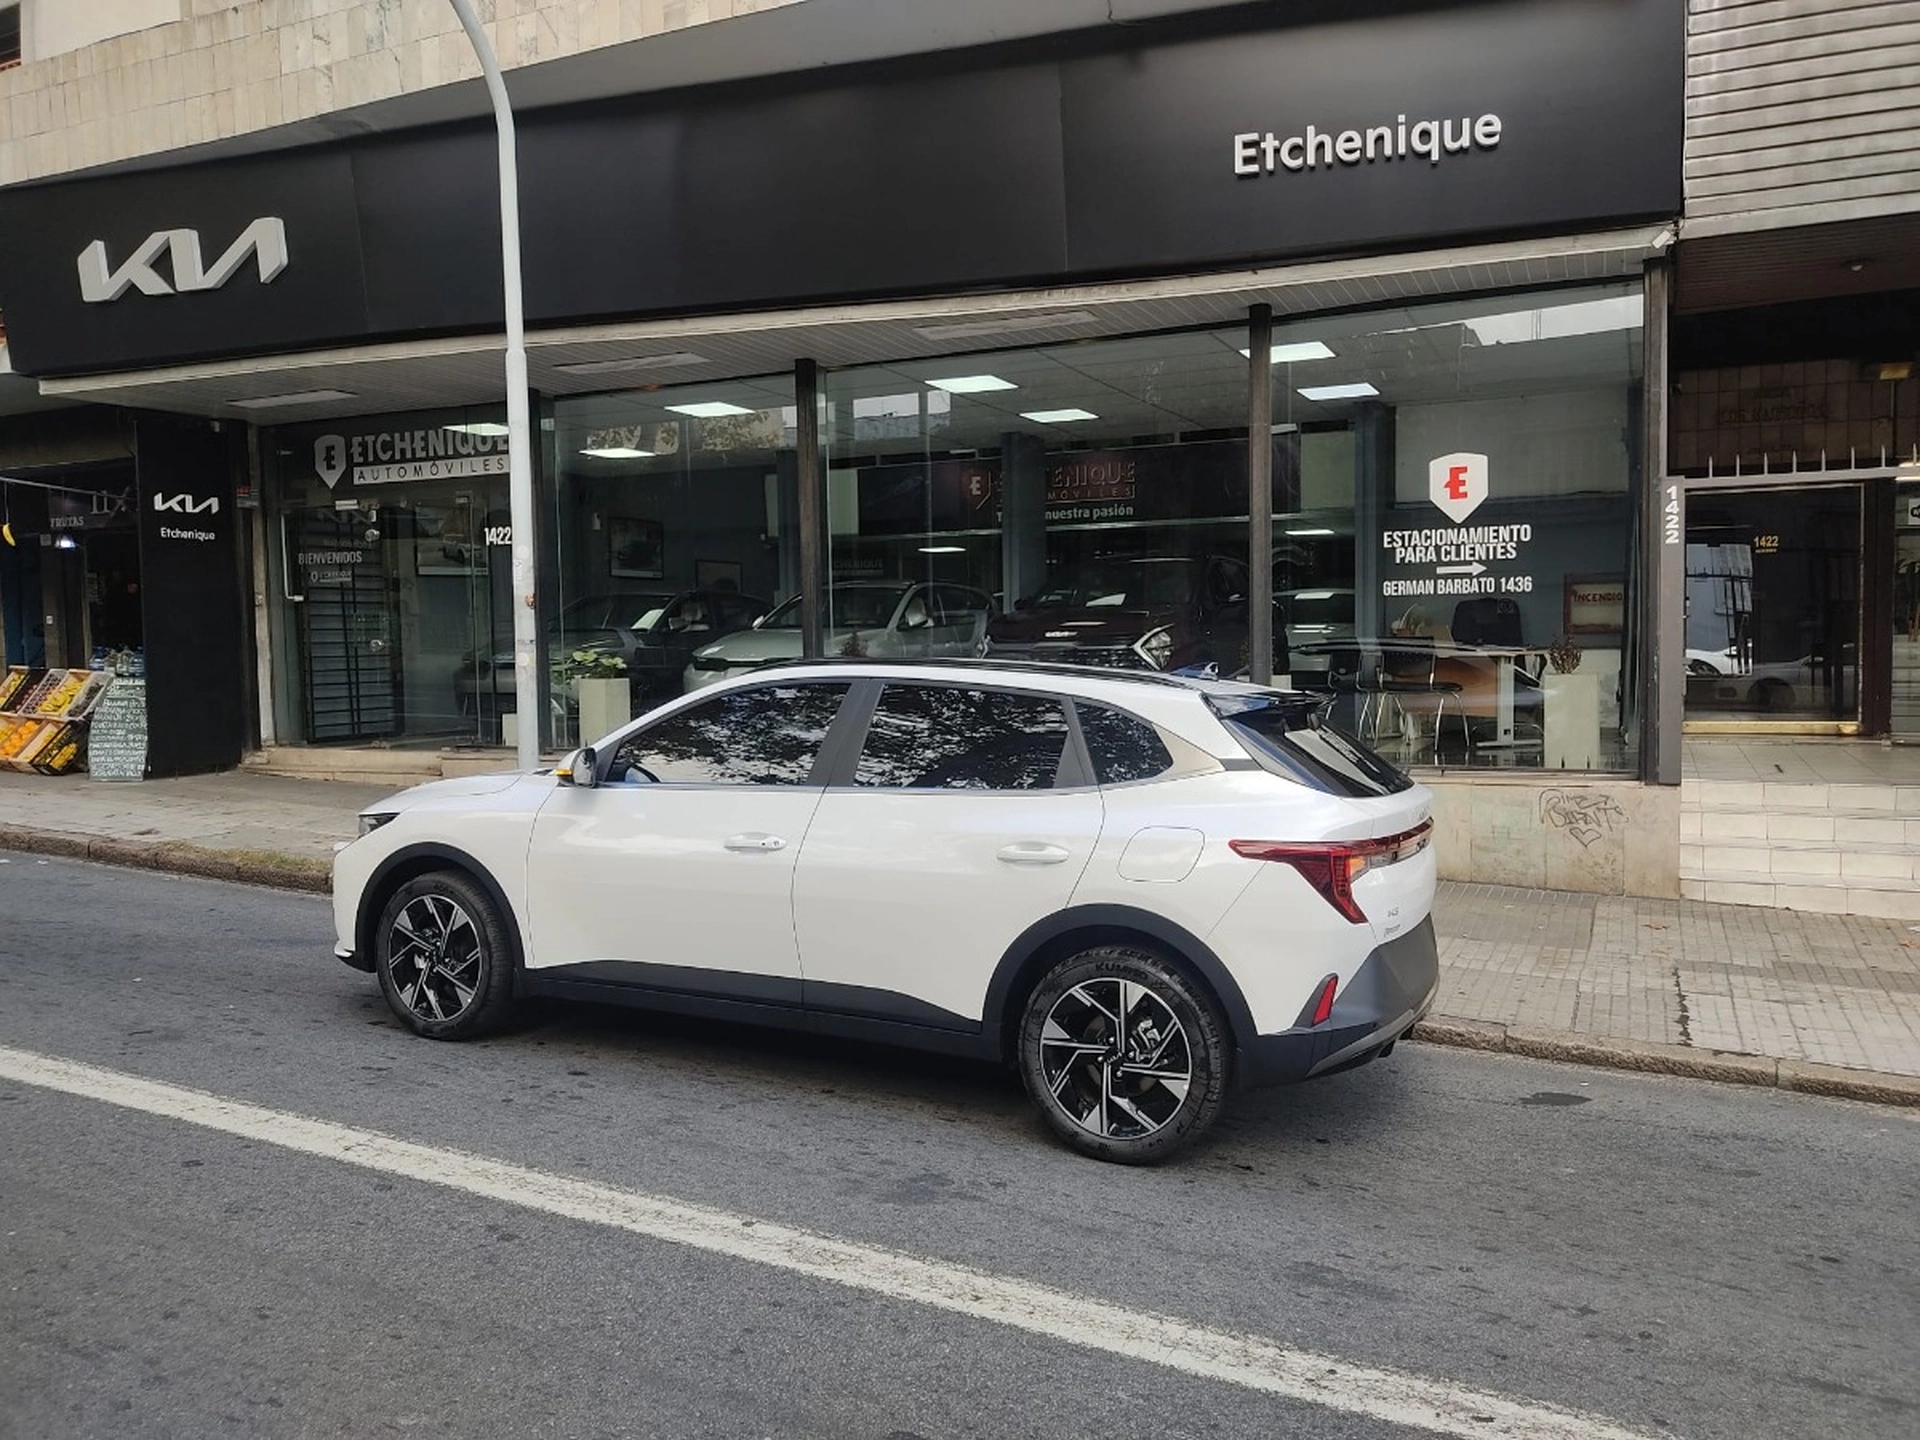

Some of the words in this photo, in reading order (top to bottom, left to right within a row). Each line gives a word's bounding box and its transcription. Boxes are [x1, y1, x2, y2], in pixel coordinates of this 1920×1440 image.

[1234, 113, 1503, 175] Etchenique
[77, 216, 289, 303] KIA
[357, 459, 505, 482] AUTOMÓVILES
[153, 491, 220, 516] KIA
[1045, 508, 1091, 521] nuestra
[1092, 503, 1134, 520] pasión
[50, 516, 85, 528] FRUTAS
[1665, 485, 1680, 544] 1422
[160, 527, 216, 542] Etchenique
[484, 527, 512, 546] 1422
[1383, 524, 1532, 548] ESTACIONAMIENTO
[1753, 535, 1779, 548] 1422
[298, 551, 363, 565] BIENVENIDOS
[1395, 546, 1437, 564] PARA
[1440, 542, 1517, 562] CLIENTES
[1383, 579, 1435, 596] GERMAN
[1437, 577, 1496, 595] BARBATO
[1499, 576, 1533, 593] 1436
[1574, 590, 1623, 602] INCENDIO
